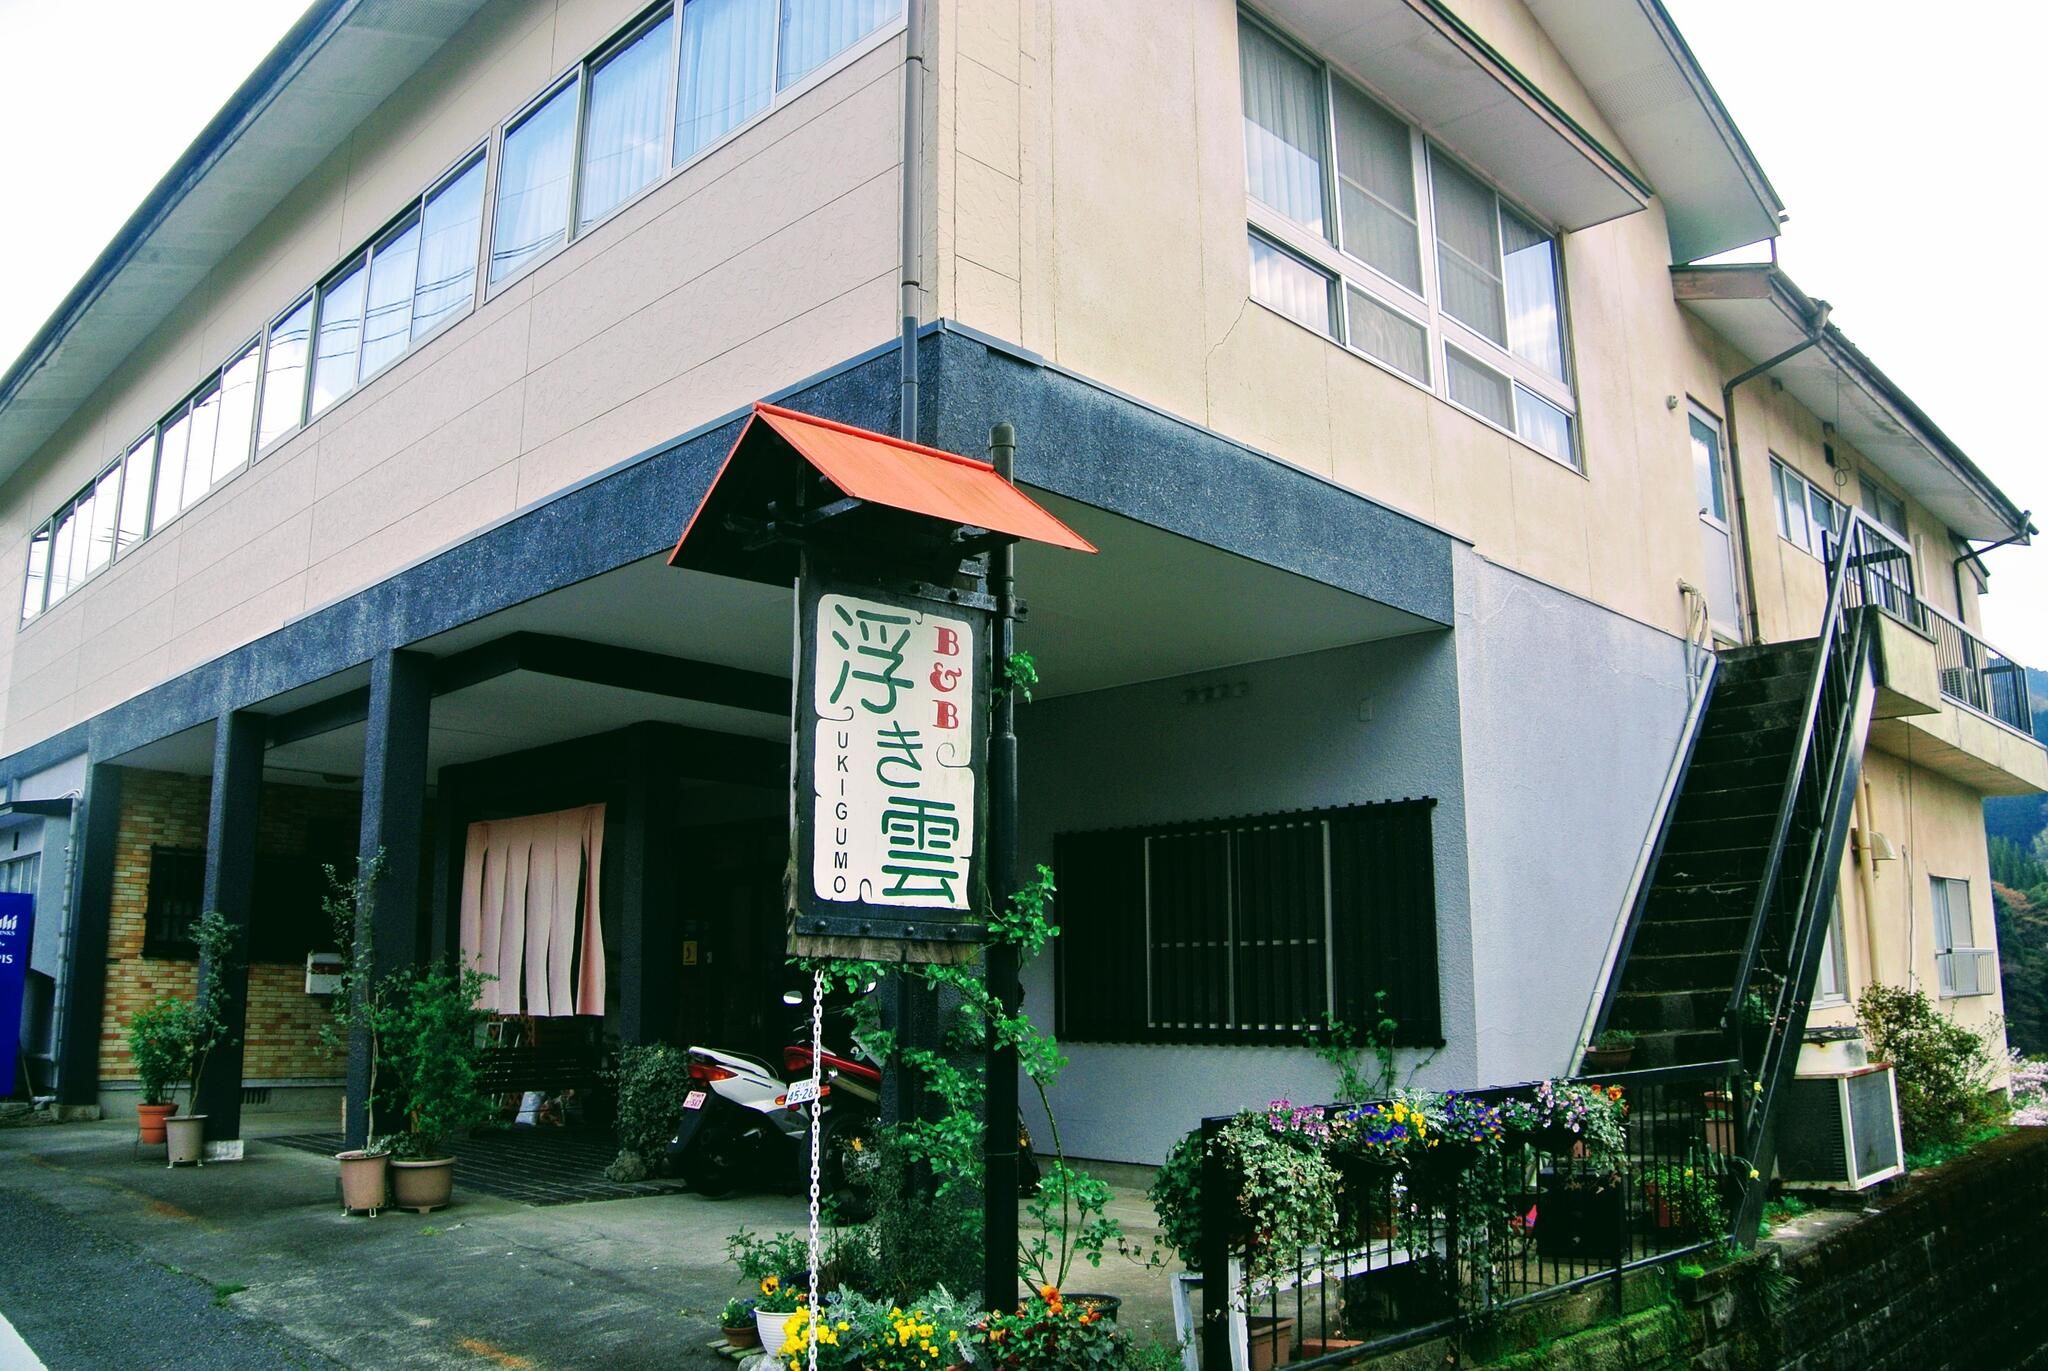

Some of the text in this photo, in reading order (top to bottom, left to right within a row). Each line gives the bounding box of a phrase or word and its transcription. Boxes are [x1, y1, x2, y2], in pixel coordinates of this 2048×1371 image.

[829, 603, 960, 904] 浮き雲
[929, 625, 962, 730] B&B
[833, 730, 850, 894] UKIGUMO
